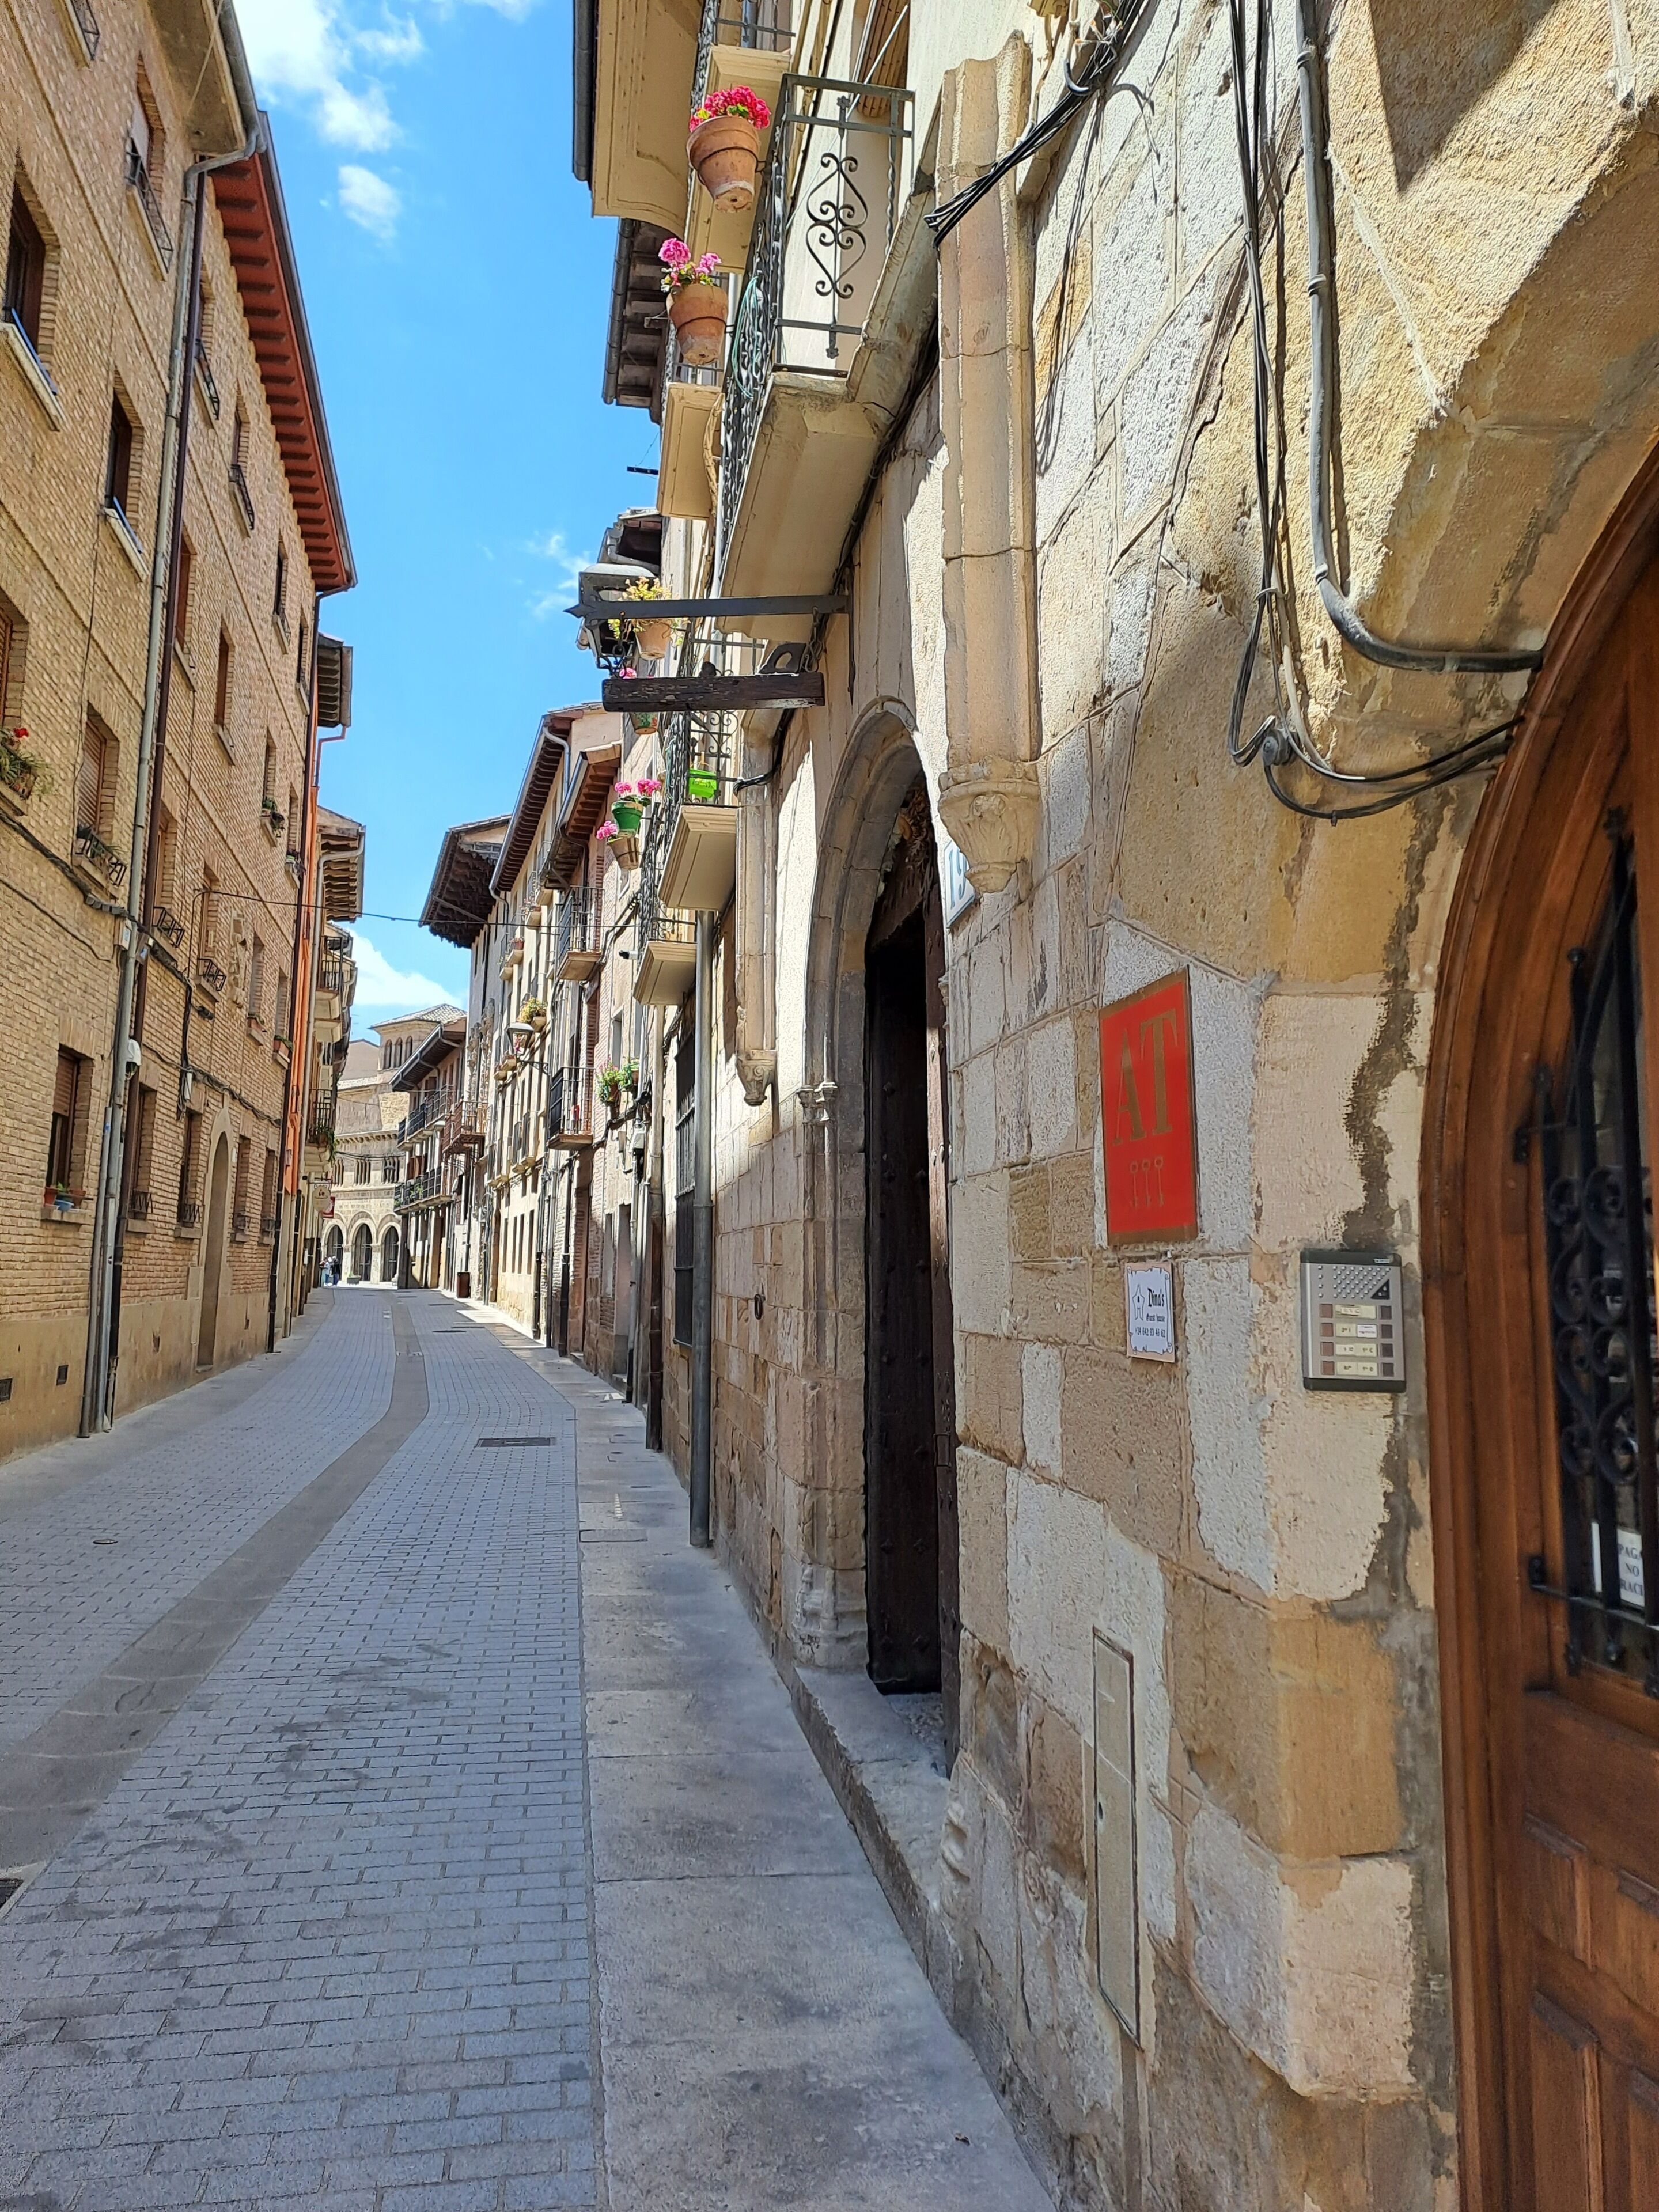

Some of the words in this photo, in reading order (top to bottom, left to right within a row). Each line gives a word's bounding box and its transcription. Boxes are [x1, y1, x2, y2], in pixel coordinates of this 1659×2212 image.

[949, 848, 967, 909] 19
[1113, 1008, 1177, 1145] AT
[1147, 1287, 1164, 1307] Dina's
[1618, 1543, 1641, 1560] PAG
[1625, 1562, 1639, 1577] NO
